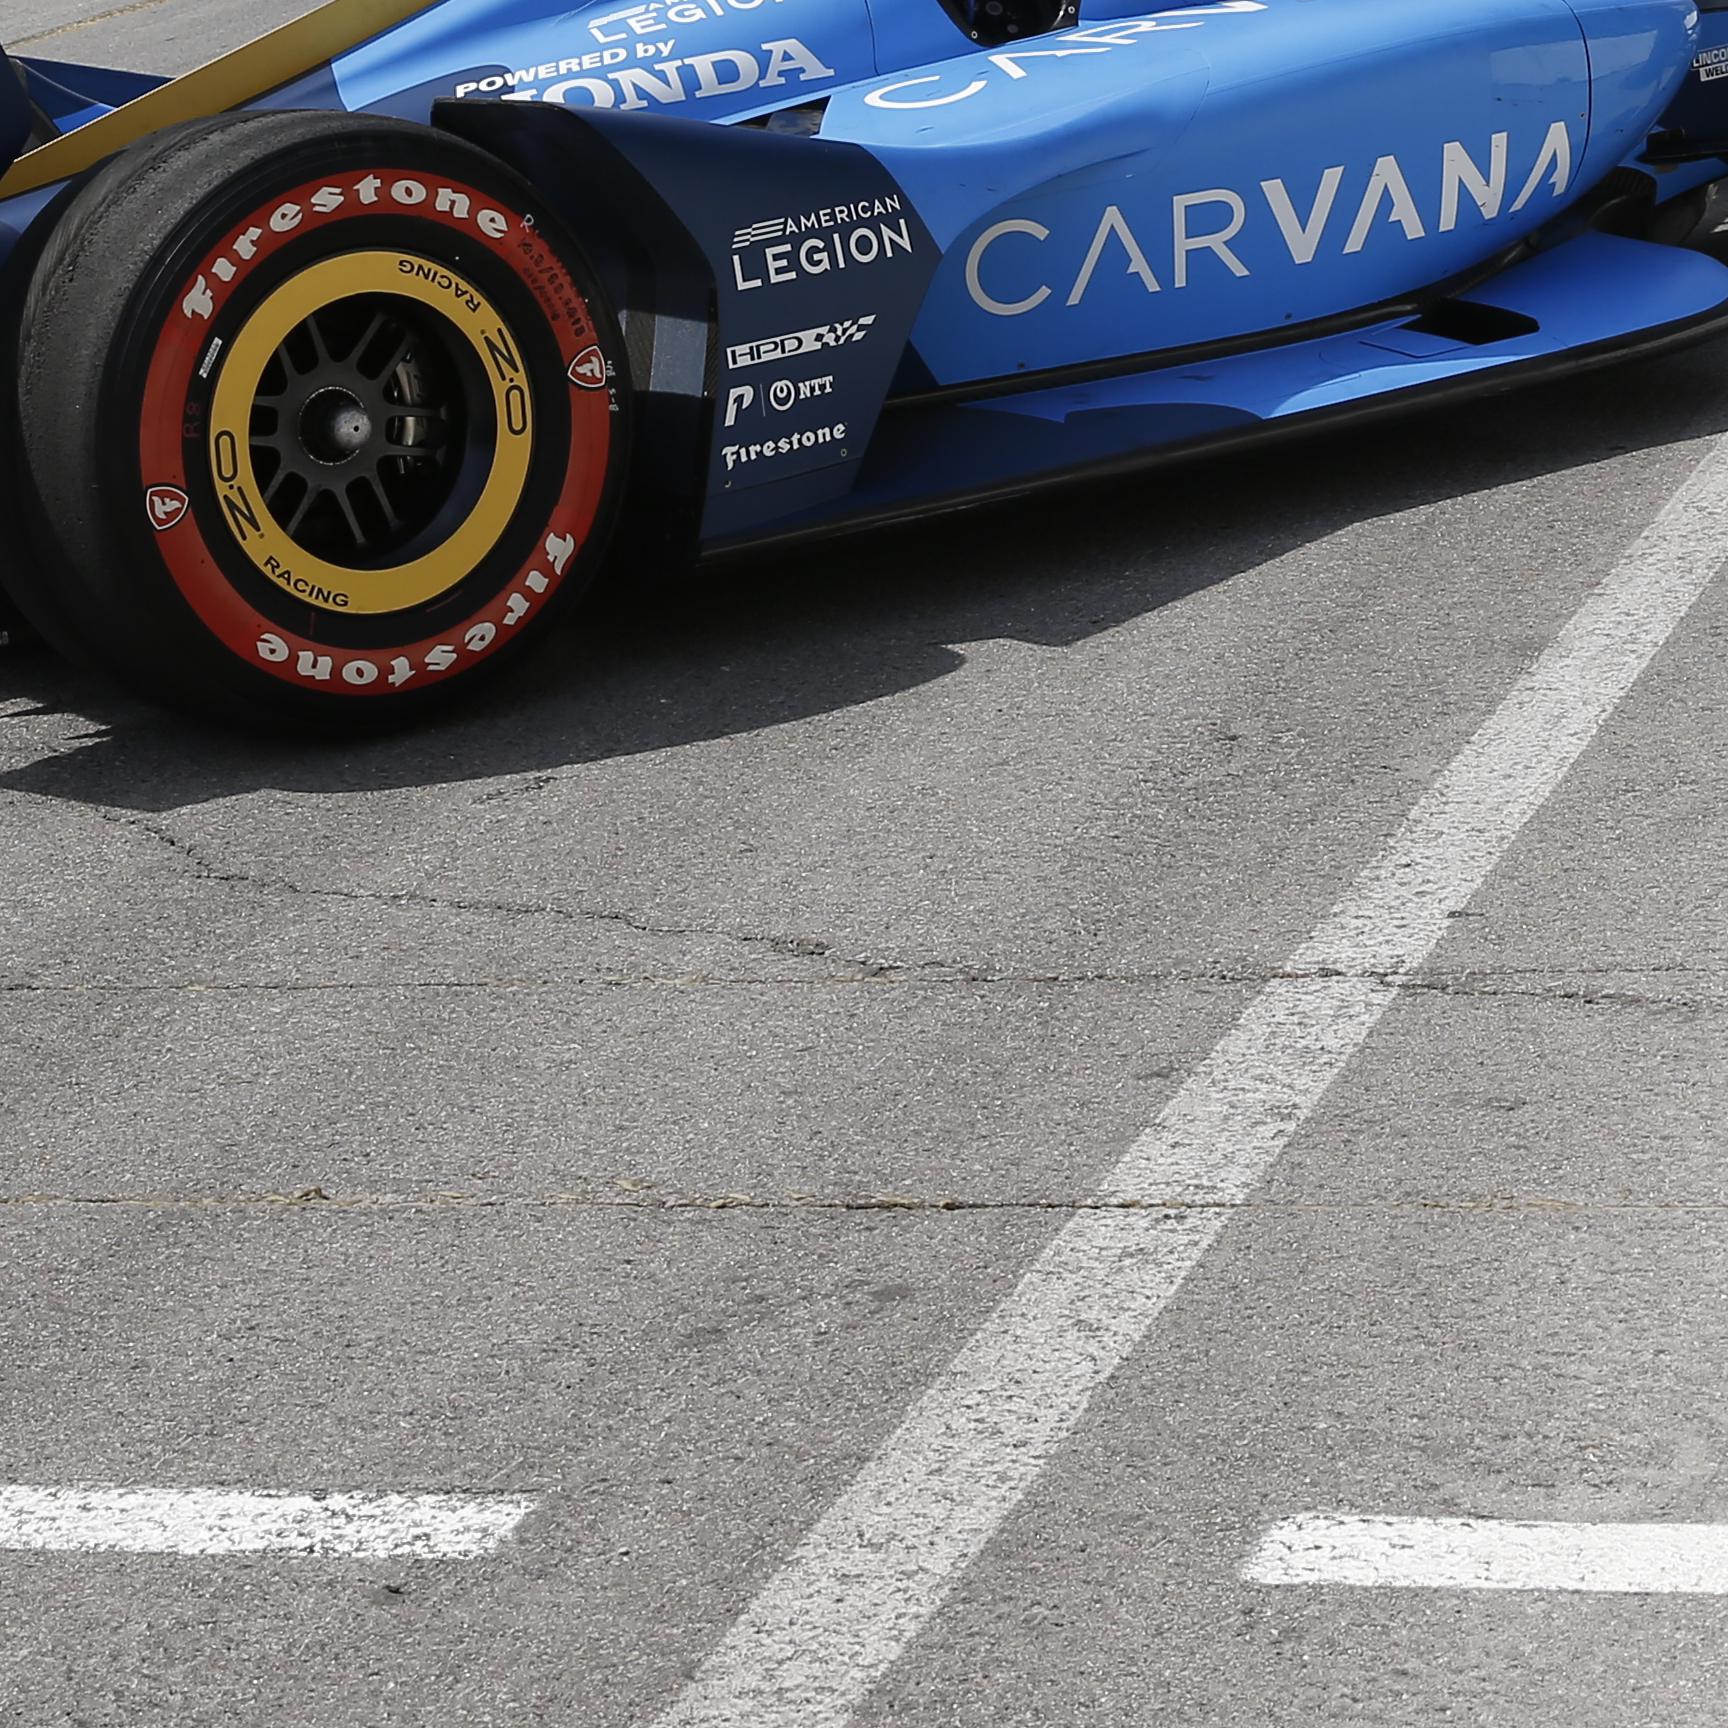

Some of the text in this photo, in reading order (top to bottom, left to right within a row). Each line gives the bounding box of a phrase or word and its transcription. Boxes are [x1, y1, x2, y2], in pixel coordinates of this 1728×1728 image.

[455, 38, 677, 99] POWERED by
[784, 193, 903, 236] AMERICAN
[964, 120, 1573, 318] CARVANA
[182, 172, 509, 321] Firestone
[731, 217, 914, 292] LEGION
[396, 257, 482, 314] RACING
[729, 334, 804, 367] HPD
[797, 375, 835, 401] NTT
[721, 422, 849, 472] Firestone
[256, 530, 576, 688] Firestone
[263, 554, 351, 609] RACING
